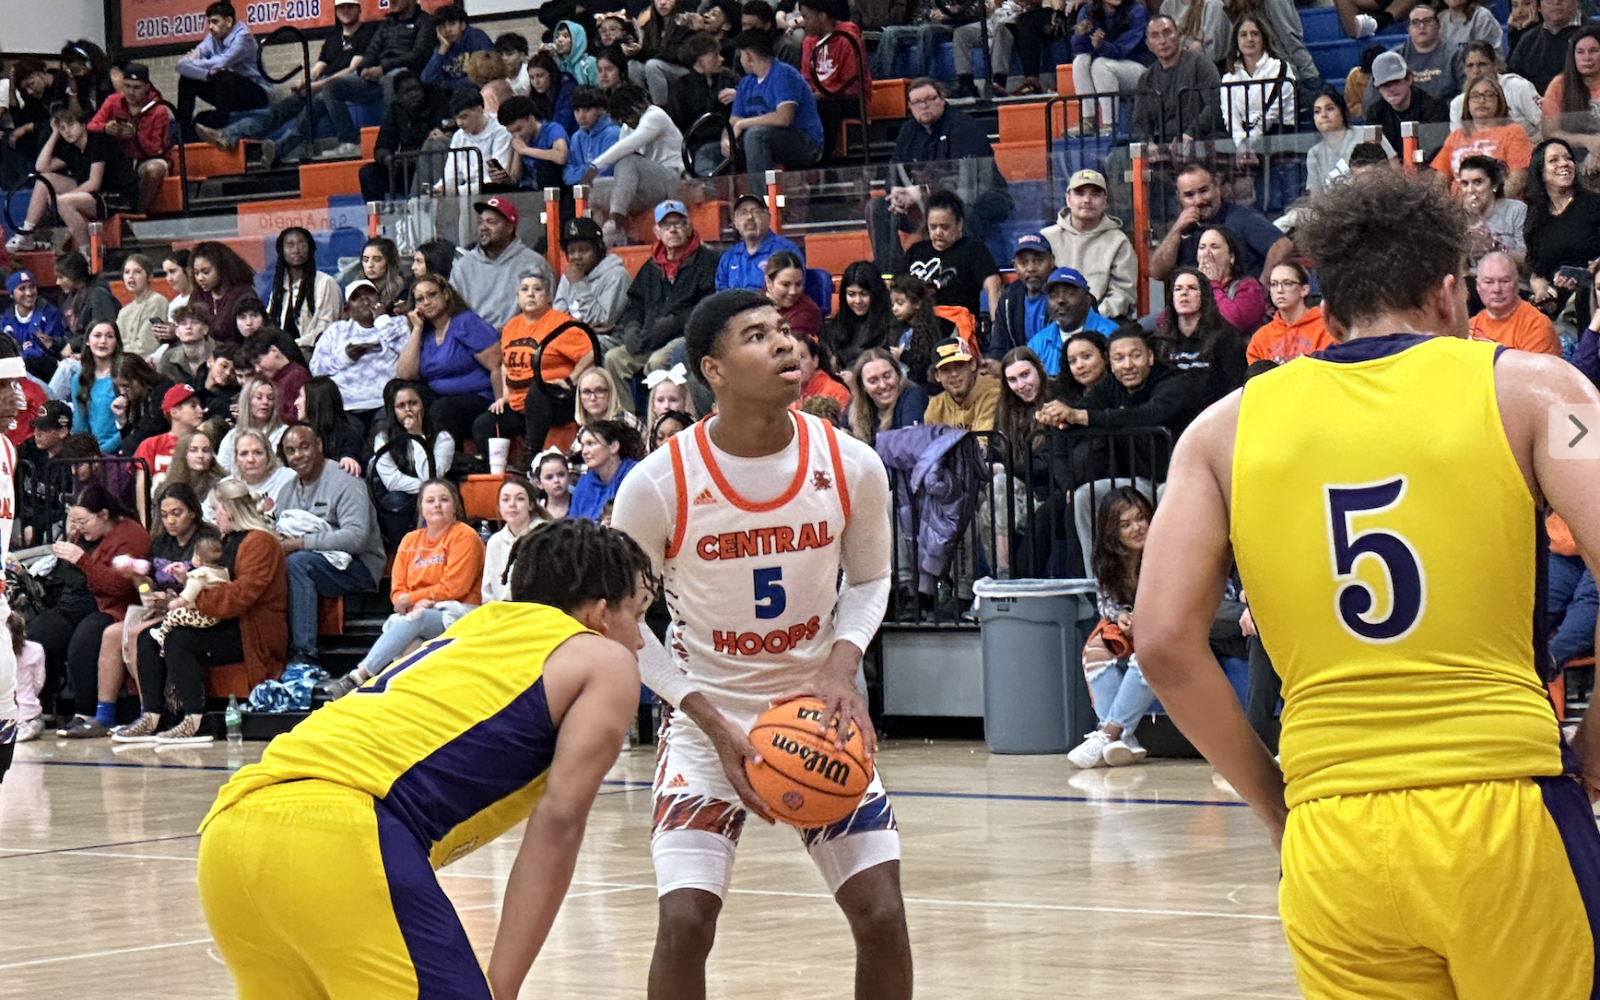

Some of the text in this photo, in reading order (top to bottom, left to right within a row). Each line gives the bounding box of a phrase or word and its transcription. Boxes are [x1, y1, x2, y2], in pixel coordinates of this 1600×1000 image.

[136, 13, 207, 38] 2016-2017
[247, 0, 320, 24] 2017-2018
[696, 520, 834, 561] CENTRAL
[1322, 472, 1427, 645] 5
[752, 566, 787, 620] 5
[712, 615, 821, 656] HOOPS
[771, 732, 851, 787] Wilson
